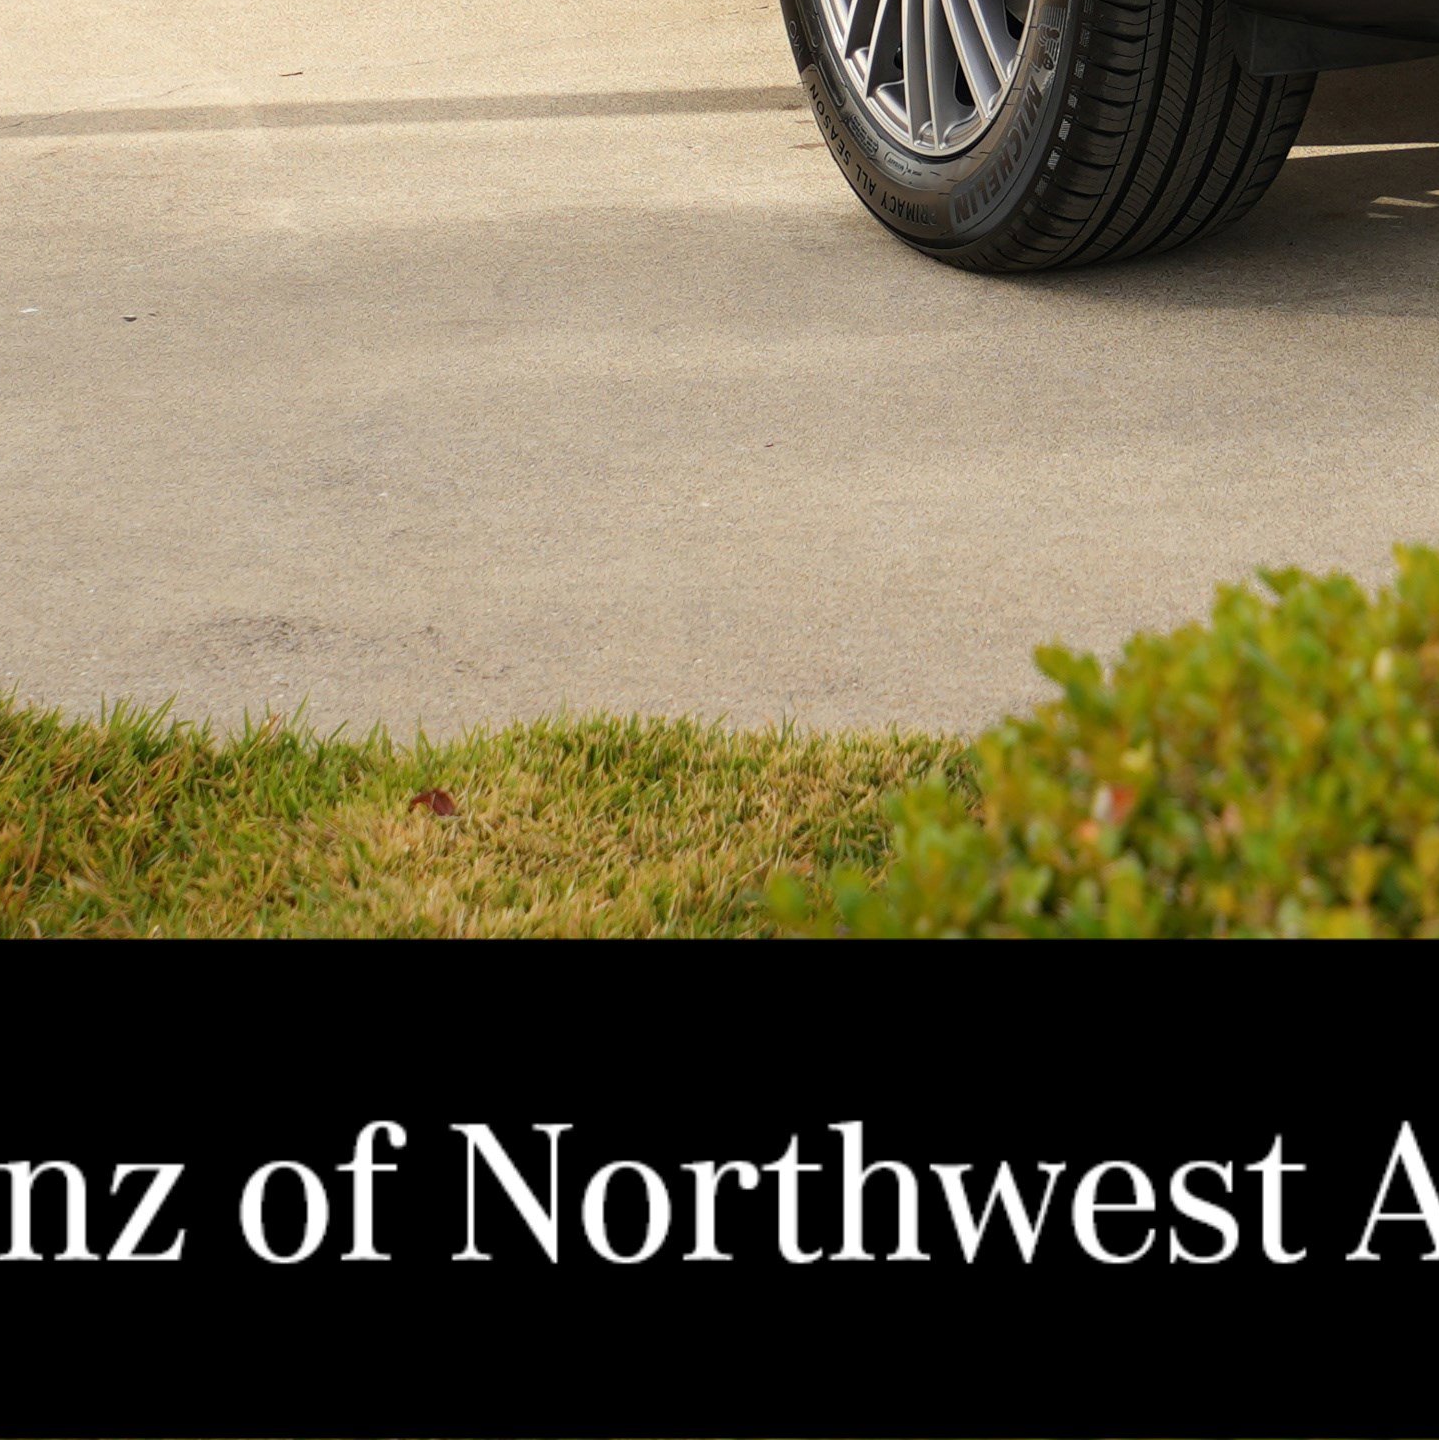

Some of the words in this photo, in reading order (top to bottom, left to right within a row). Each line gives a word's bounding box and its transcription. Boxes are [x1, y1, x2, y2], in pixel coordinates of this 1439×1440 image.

[809, 83, 852, 166] SEASON
[954, 75, 1043, 224] MICHELIN
[856, 163, 877, 196] ALL
[880, 190, 938, 226] PRIMACY
